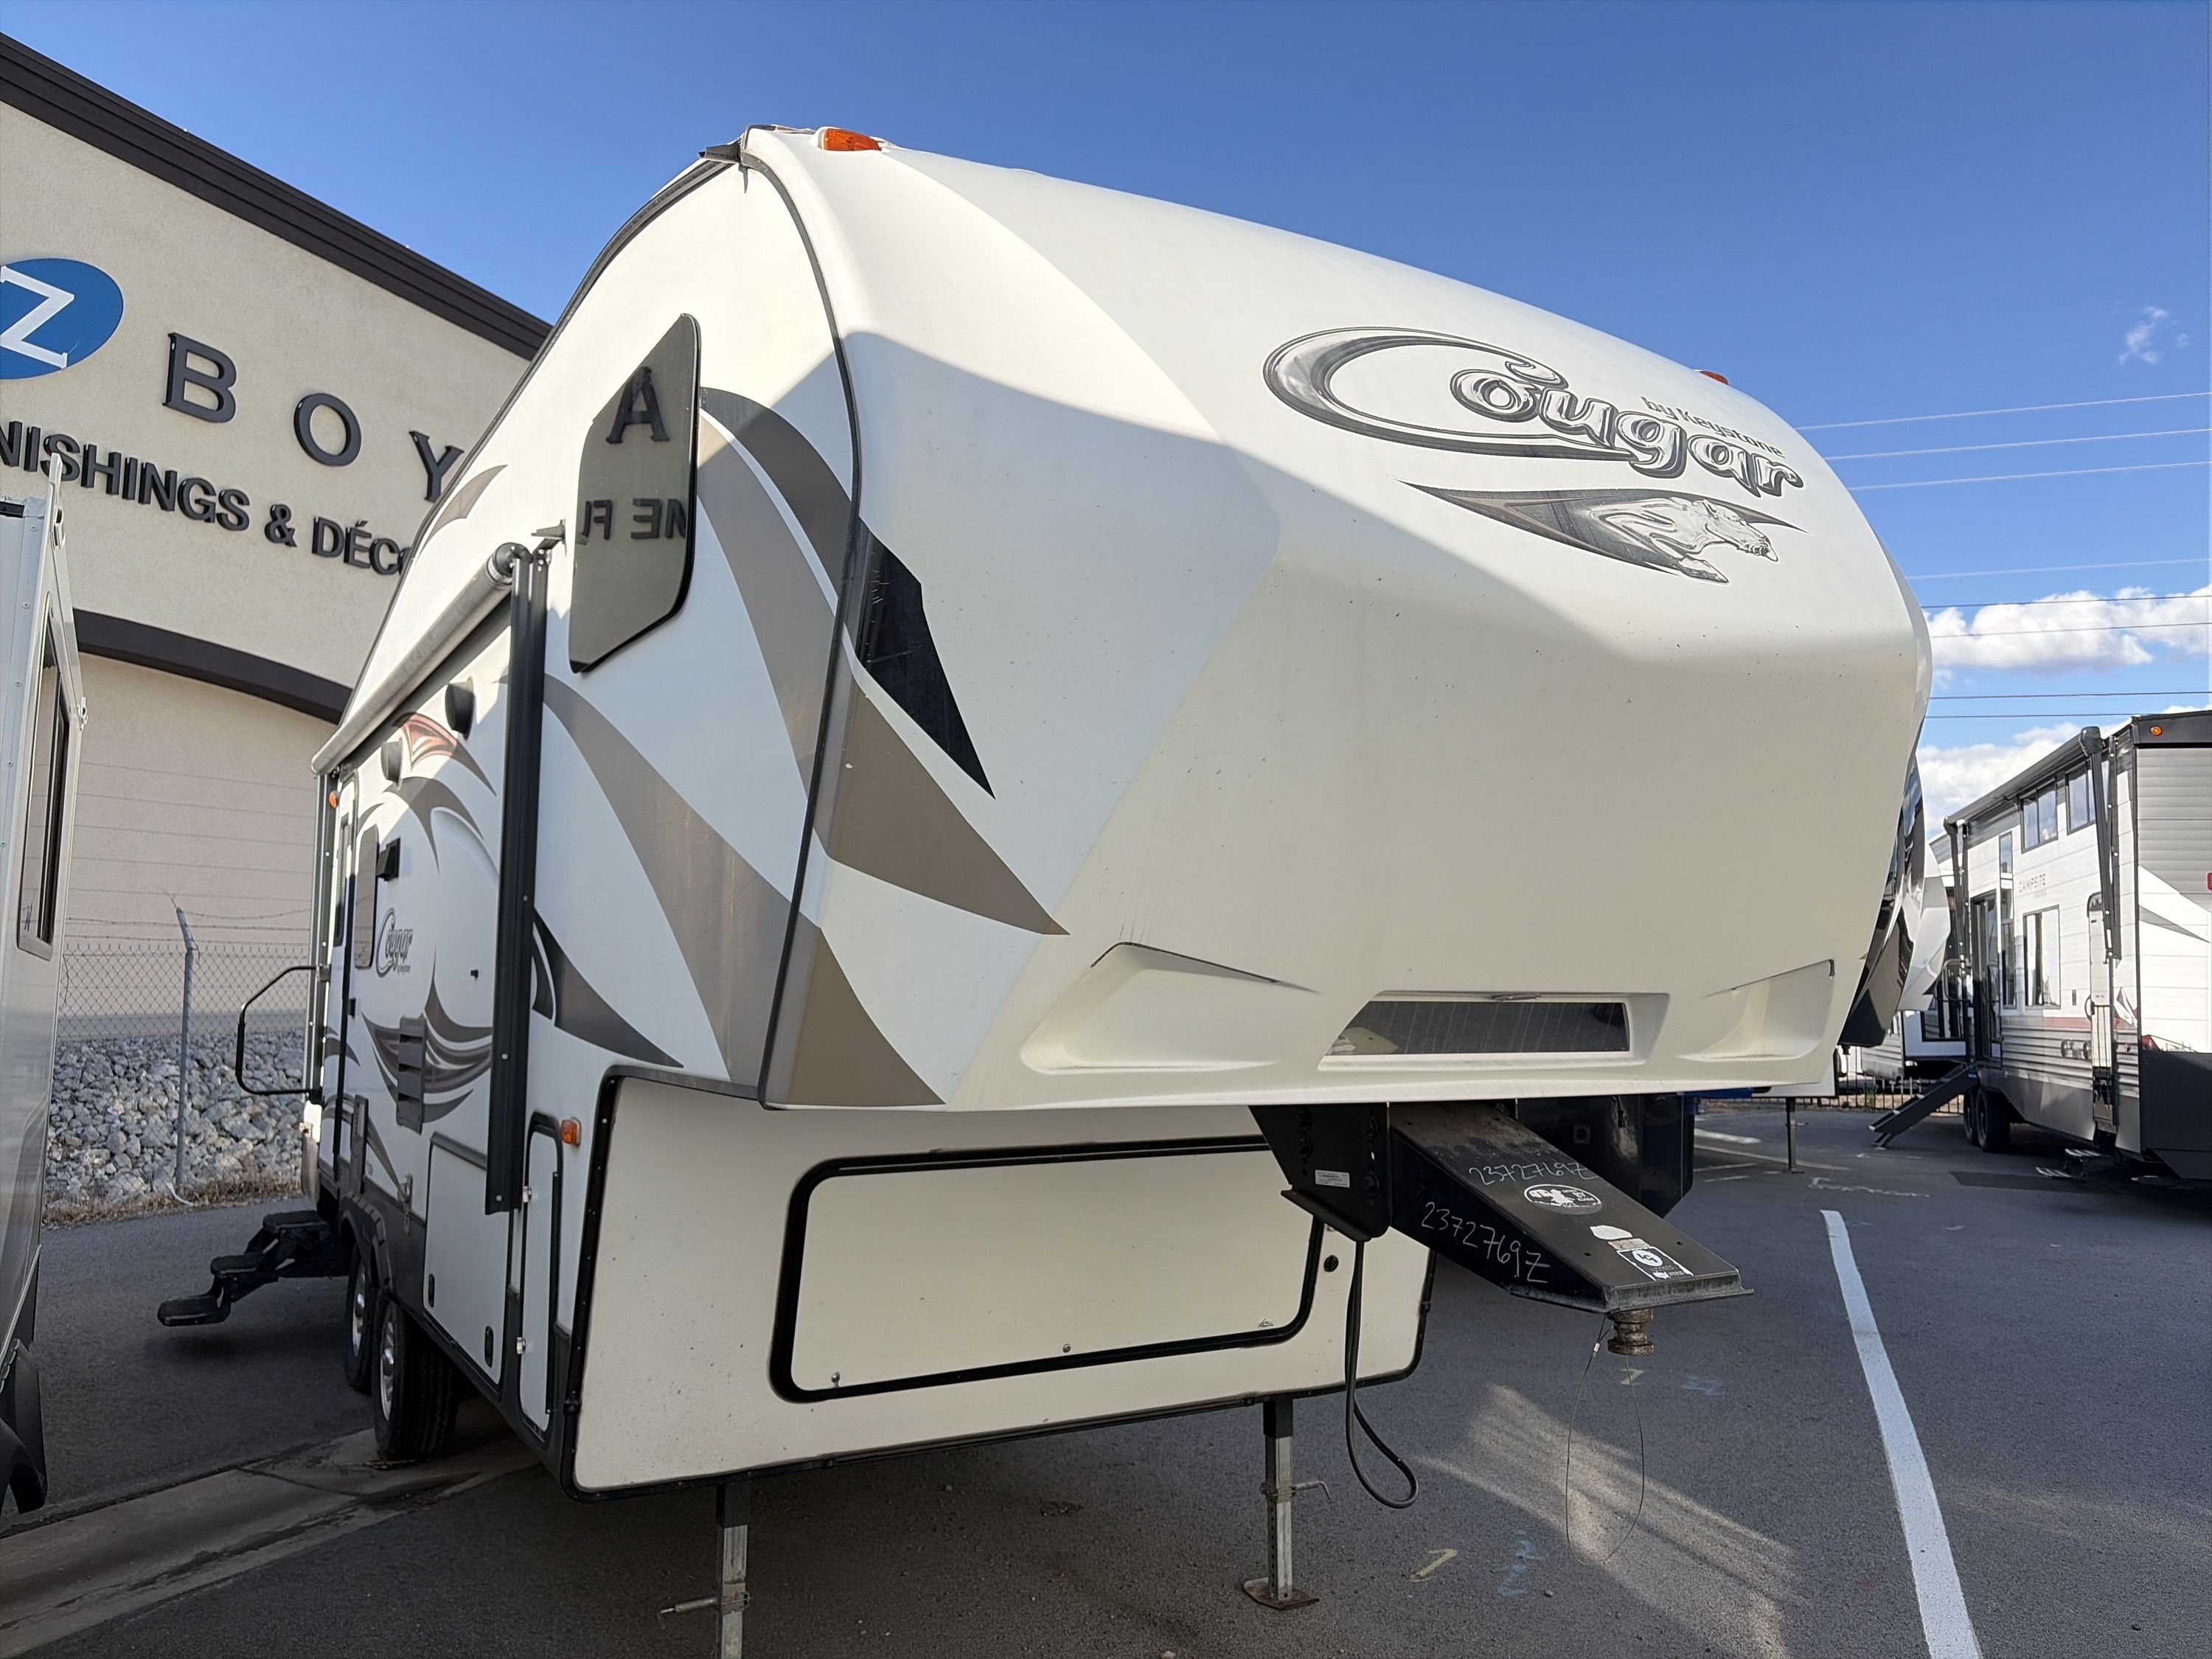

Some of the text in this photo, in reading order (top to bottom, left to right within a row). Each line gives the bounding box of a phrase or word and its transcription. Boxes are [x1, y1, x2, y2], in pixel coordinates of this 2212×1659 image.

[161, 332, 464, 504] BOY
[1263, 326, 1805, 498] Cougar
[1641, 395, 1787, 459] by Keystone
[264, 504, 297, 548] &
[375, 907, 414, 978] Cougar
